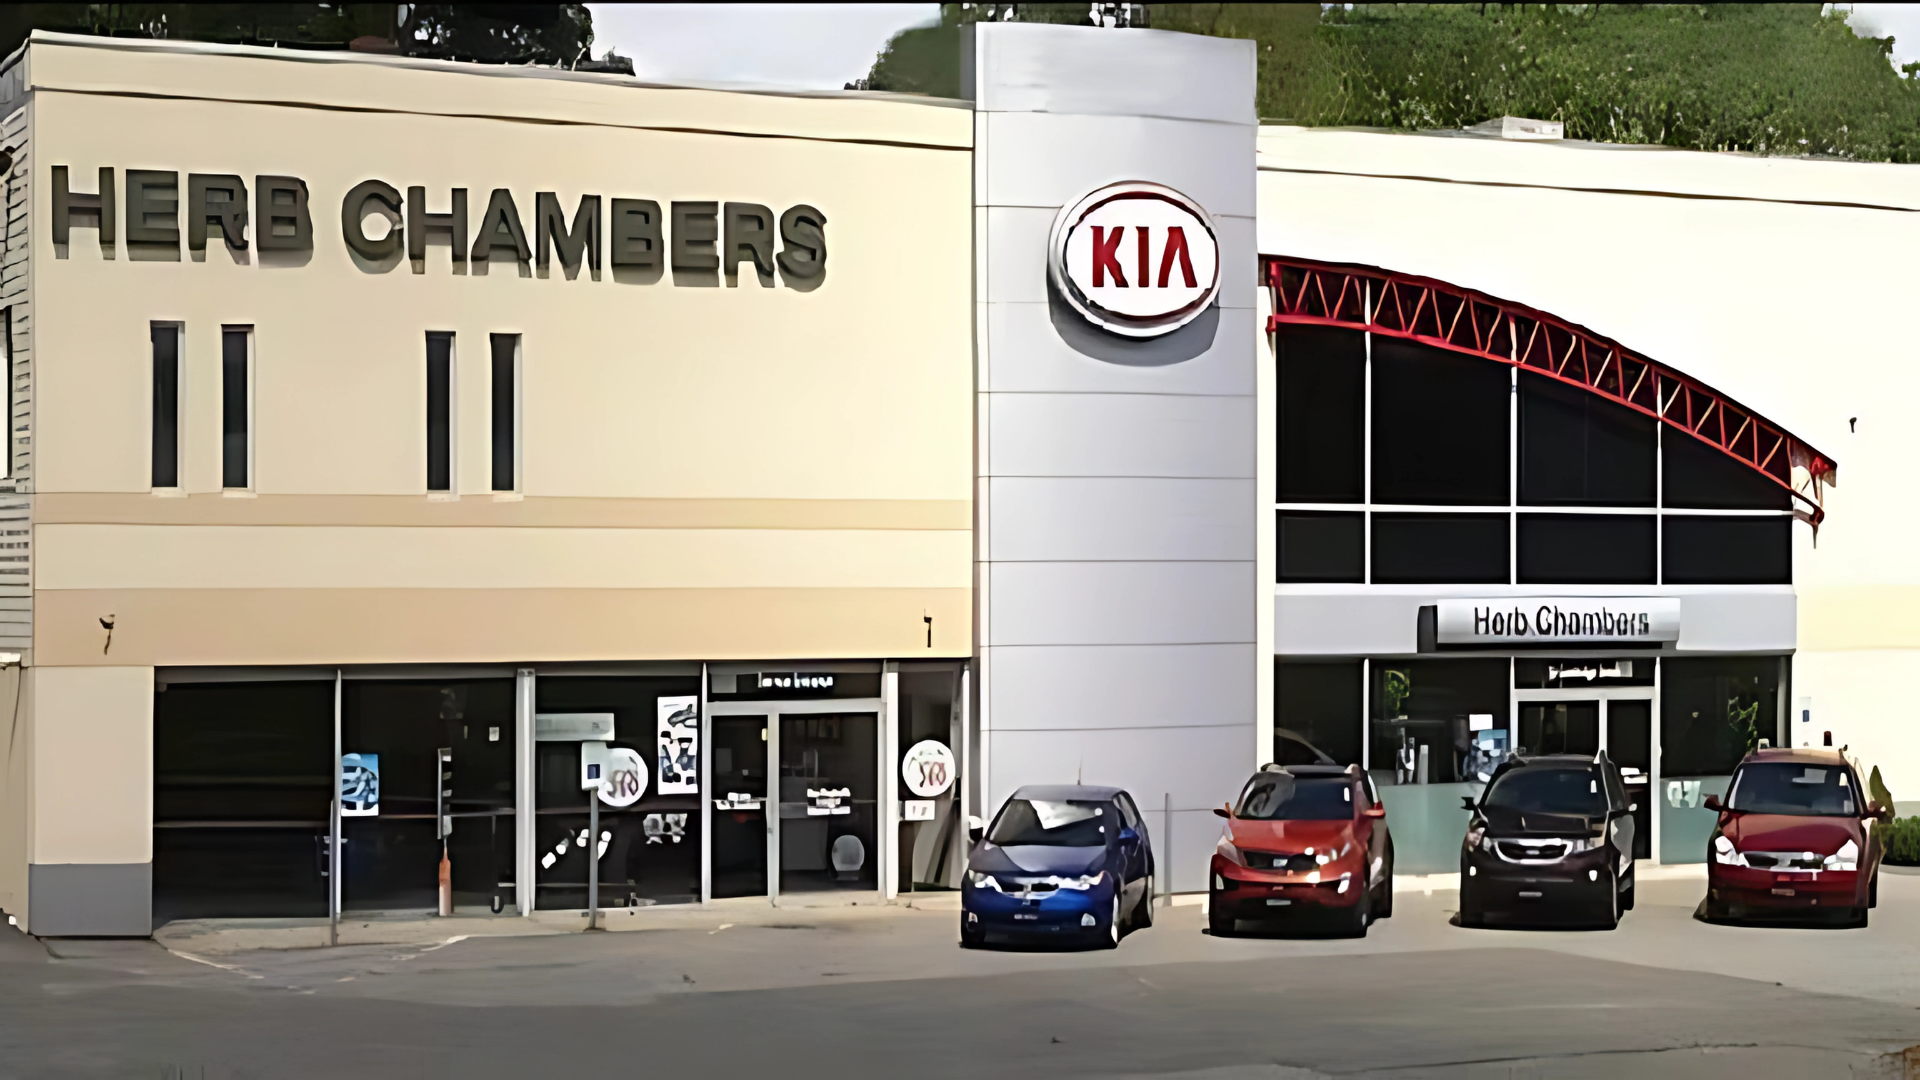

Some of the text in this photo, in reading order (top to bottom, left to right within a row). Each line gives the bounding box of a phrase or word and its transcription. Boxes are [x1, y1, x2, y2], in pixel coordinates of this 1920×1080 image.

[51, 165, 828, 292] HERB CHAMBERS
[1090, 225, 1198, 288] KIA
